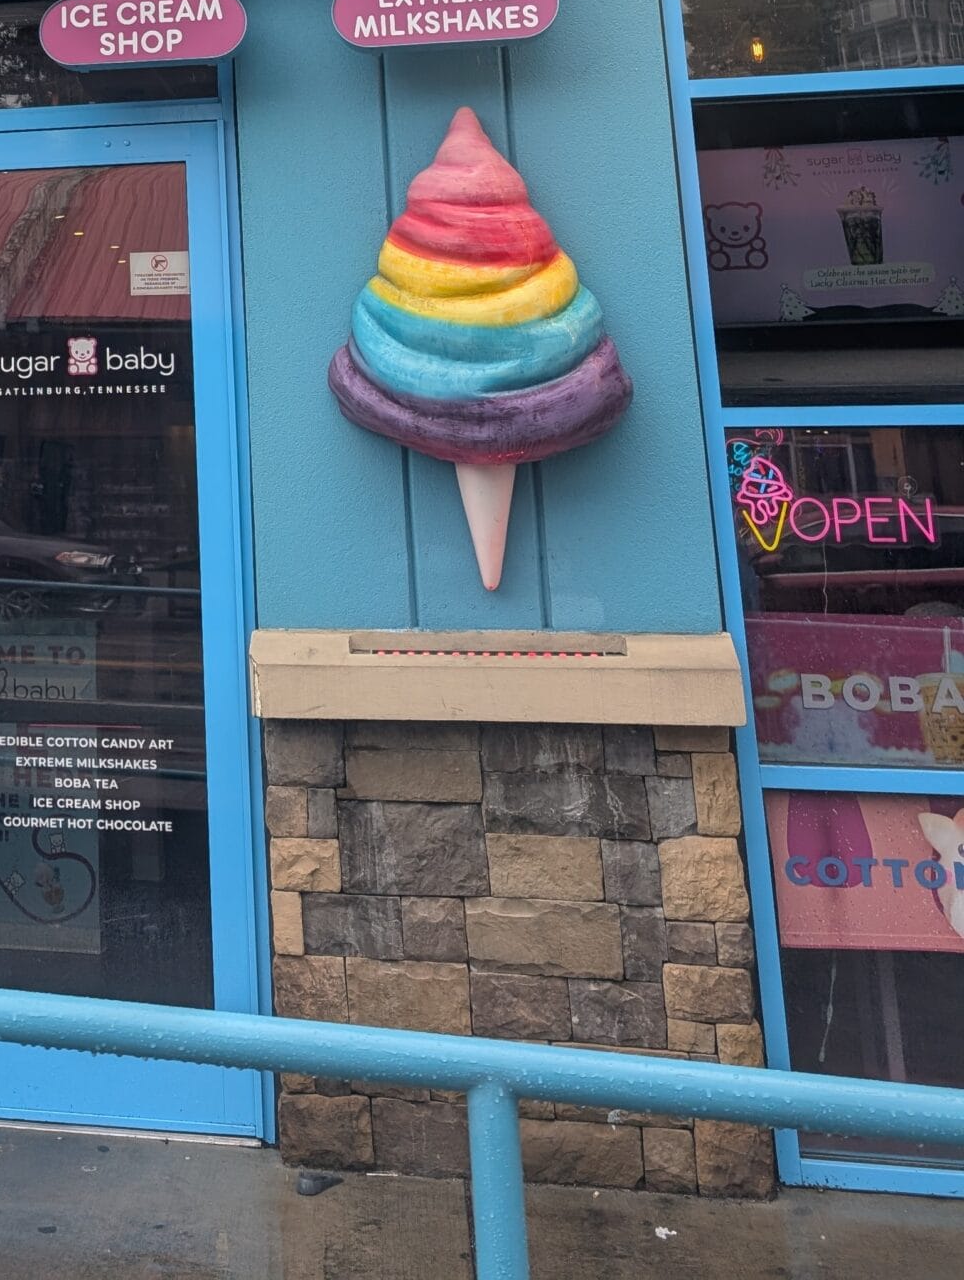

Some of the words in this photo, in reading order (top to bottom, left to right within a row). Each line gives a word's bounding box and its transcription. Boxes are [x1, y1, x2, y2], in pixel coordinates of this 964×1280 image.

[61, 3, 108, 29] ICE
[353, 4, 539, 39] MILKSHAKES
[99, 29, 183, 56] SHOP
[106, 346, 175, 376] baby
[789, 497, 936, 543] OPEN
[800, 673, 964, 714] BOBA
[46, 737, 98, 748] COTTON
[101, 738, 146, 749] CANDY
[148, 739, 174, 750] ART
[15, 756, 73, 768] EXTREME
[76, 758, 158, 770] MILKSHAKES
[54, 778, 91, 789] BOBA
[94, 778, 119, 789] TEA
[33, 797, 53, 808] ICE
[56, 798, 102, 810] CREAM
[105, 799, 141, 811] SHOP
[3, 816, 65, 828] GOURMET
[67, 818, 94, 829] HOT
[96, 819, 173, 832] CHOCOLATE
